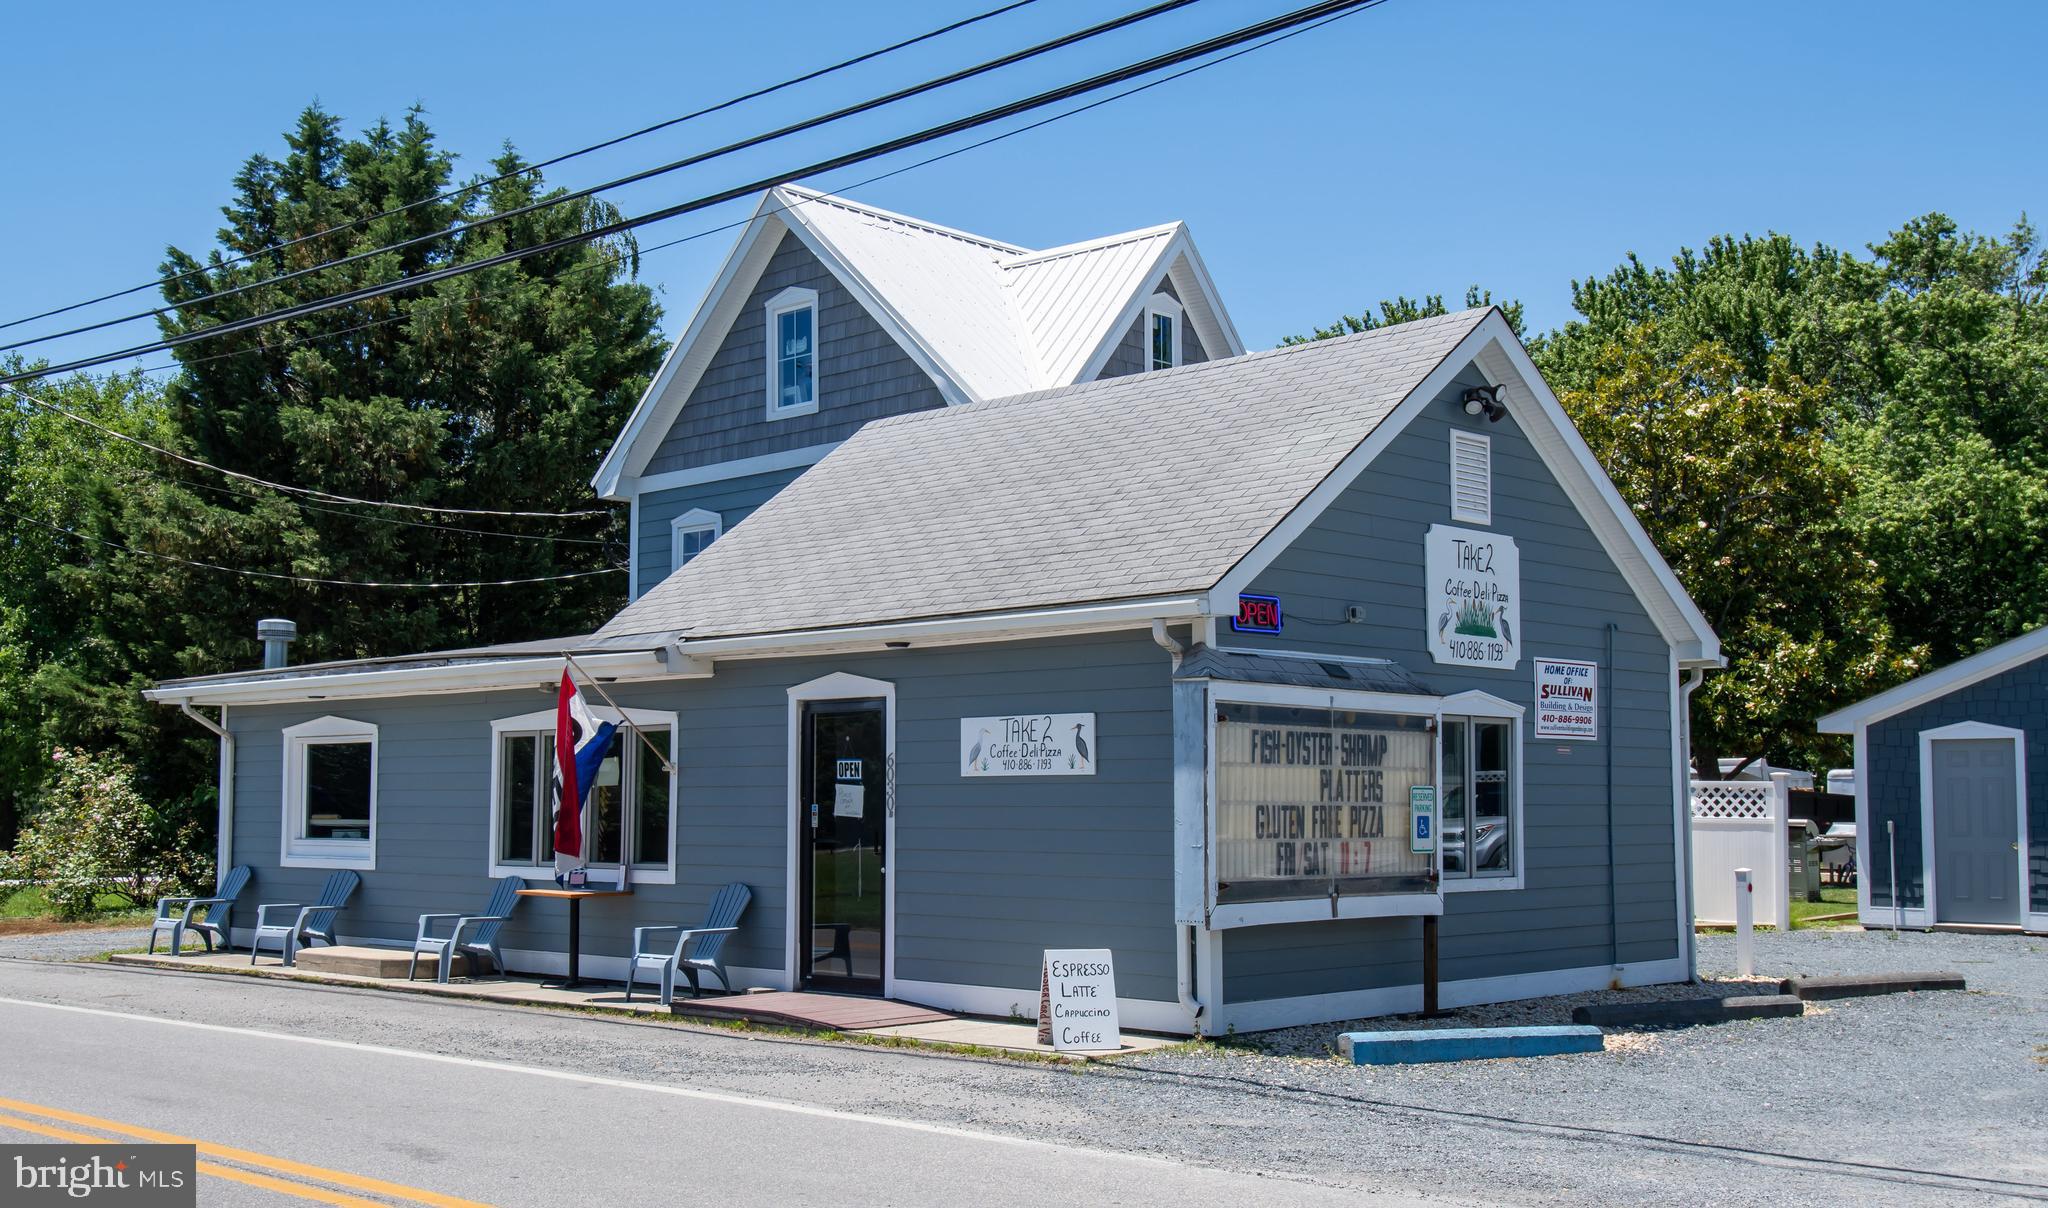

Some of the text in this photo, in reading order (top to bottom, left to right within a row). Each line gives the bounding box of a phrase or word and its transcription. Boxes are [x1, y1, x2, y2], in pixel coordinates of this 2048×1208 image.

[1445, 578, 1472, 599] Coffee
[1237, 600, 1278, 626] OPEN
[1544, 665, 1589, 677] HOME OFFICE
[1541, 684, 1593, 702] SULLIVAN
[1540, 701, 1594, 713] Building & Design
[1541, 714, 1592, 725] 410-886-9906
[1000, 715, 1054, 743] TAKE 2
[990, 743, 1018, 758] Coffee
[1021, 742, 1039, 758] Deli
[838, 761, 861, 778] OPEN
[1320, 768, 1383, 803] PLATTERS
[1255, 804, 1384, 839] GLUTEN FREE PIZZA
[1052, 960, 1110, 978] ESPRESSO
